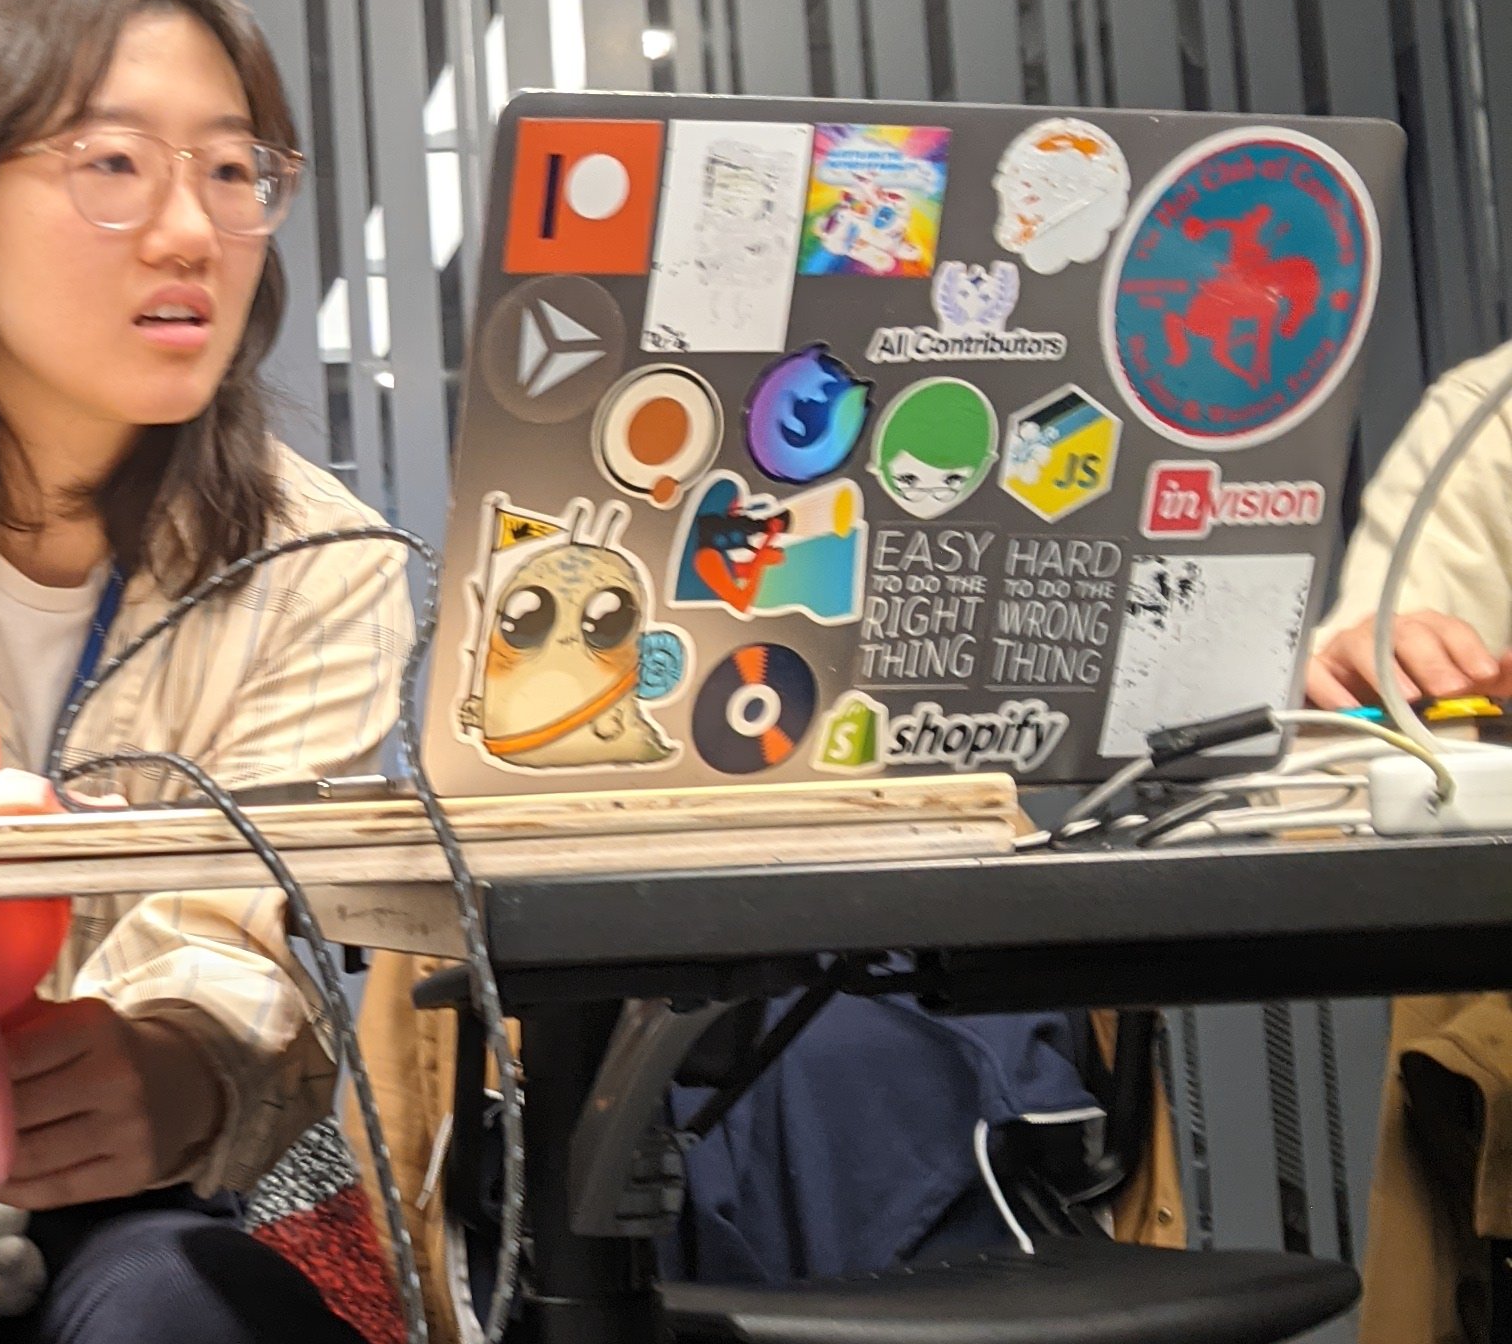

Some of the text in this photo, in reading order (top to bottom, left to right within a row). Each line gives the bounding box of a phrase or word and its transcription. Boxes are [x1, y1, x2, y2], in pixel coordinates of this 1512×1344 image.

[878, 332, 1064, 356] All Contributors
[1053, 453, 1102, 490] JS
[872, 529, 996, 573] EASY
[1004, 538, 1123, 579] HARD
[871, 574, 988, 595] TO DO THE
[1002, 578, 1117, 599] TO DO THE
[861, 595, 985, 641] RIGHT
[997, 599, 1112, 647] WRONG
[858, 633, 978, 679] THING
[991, 637, 1103, 685] THING
[887, 708, 1061, 765] shopify
